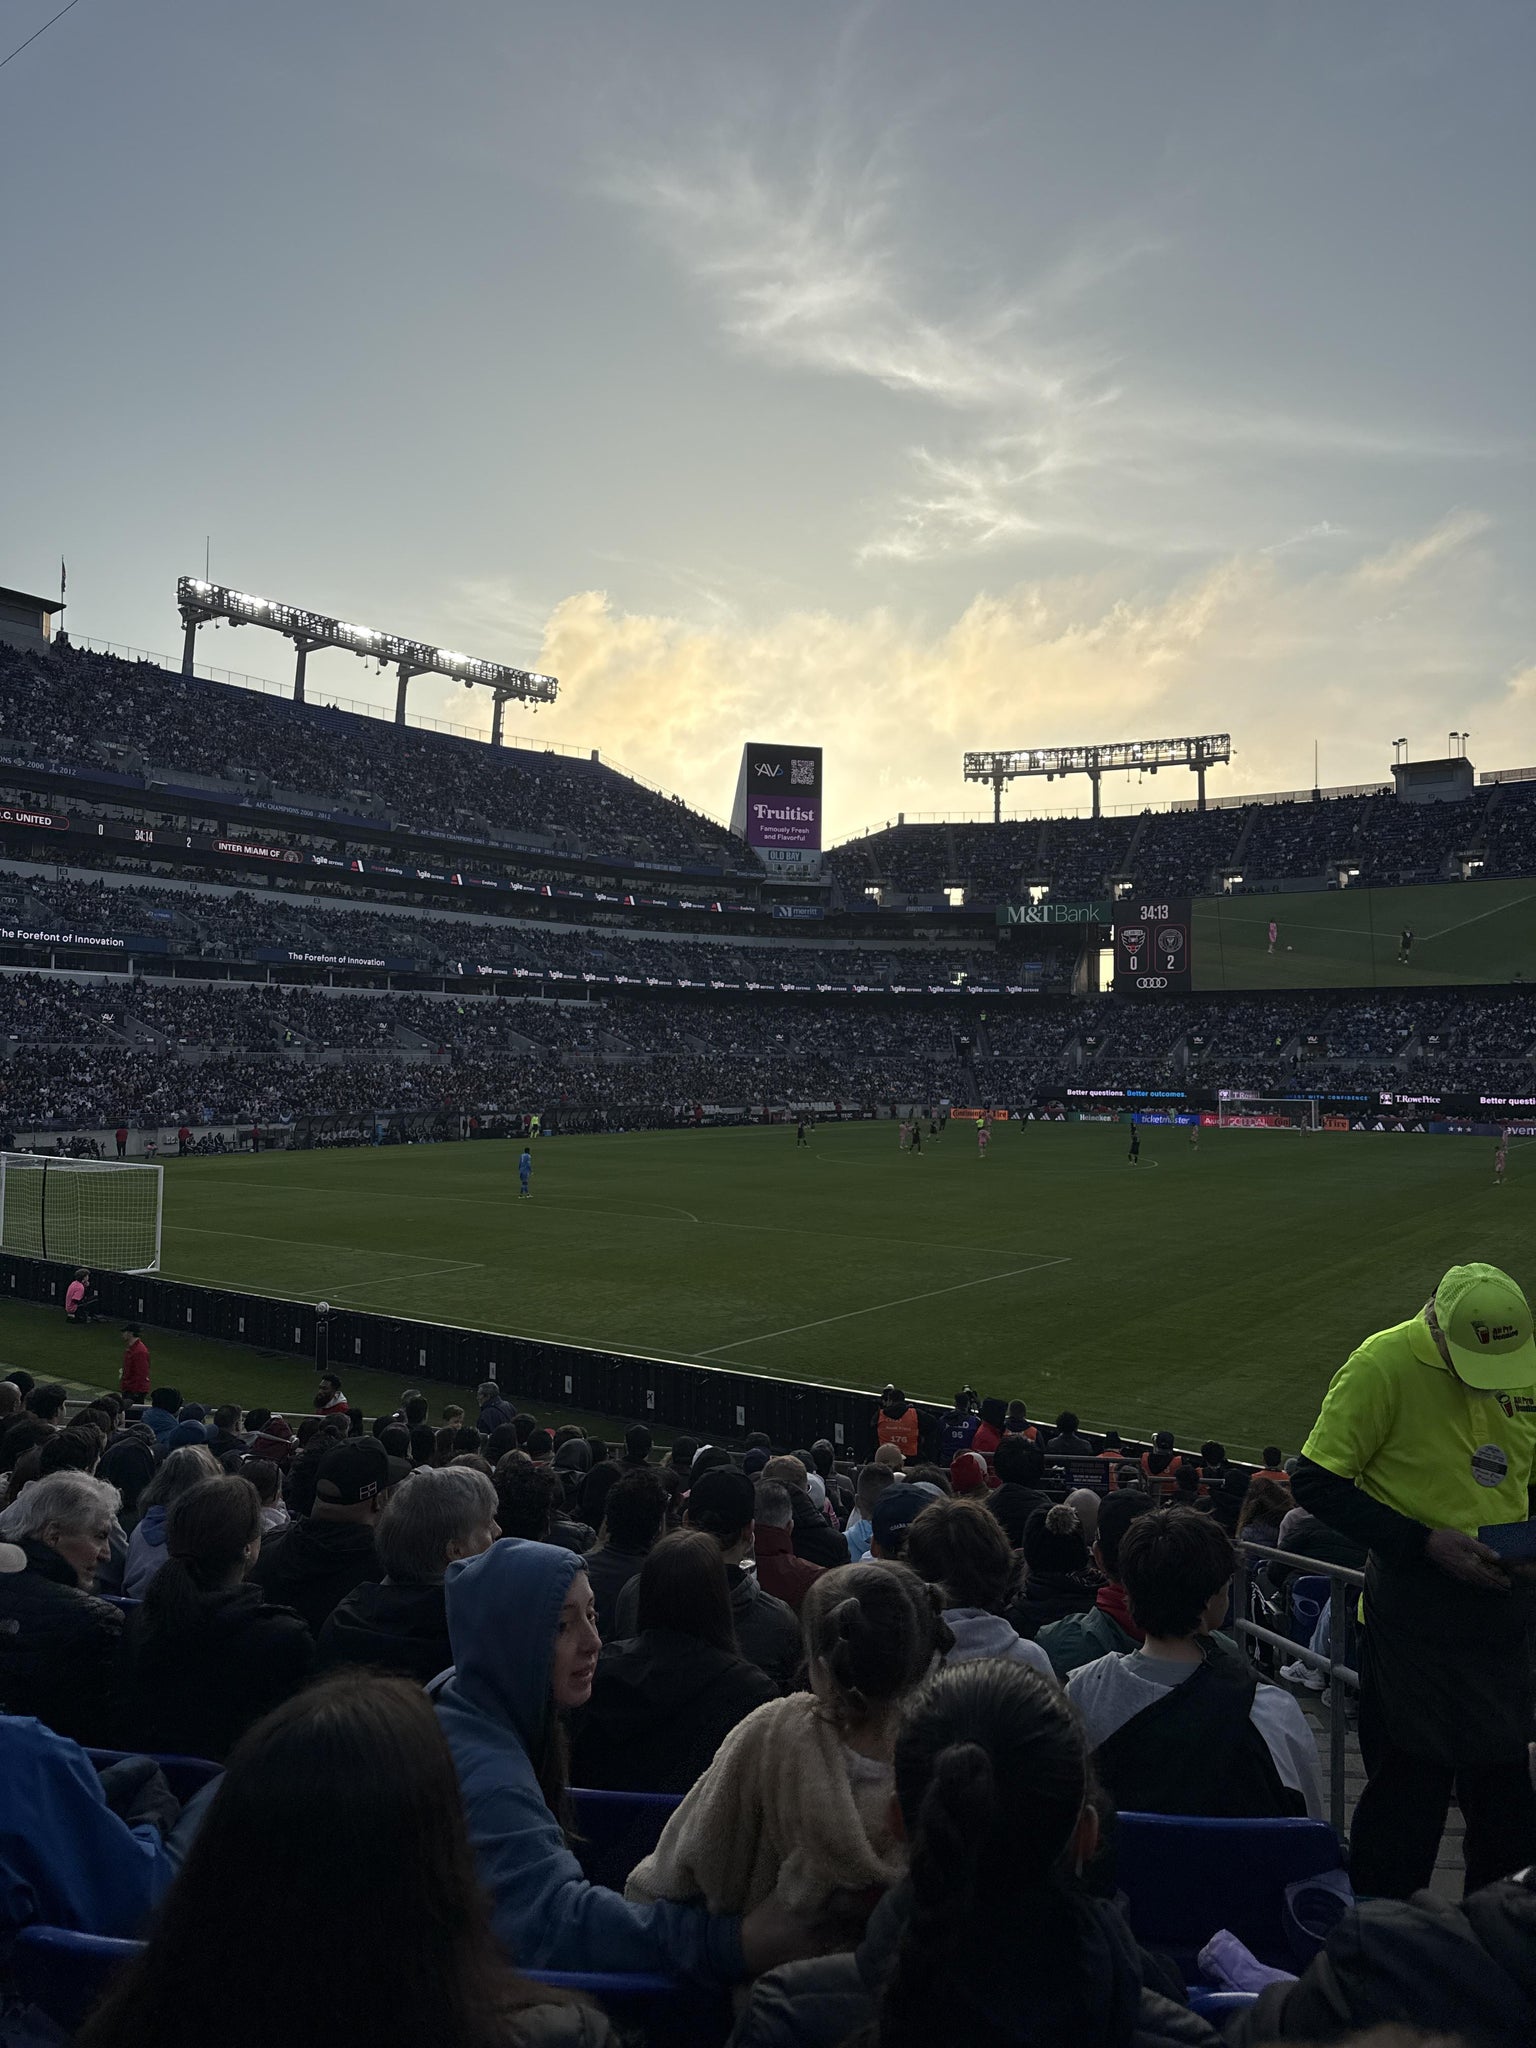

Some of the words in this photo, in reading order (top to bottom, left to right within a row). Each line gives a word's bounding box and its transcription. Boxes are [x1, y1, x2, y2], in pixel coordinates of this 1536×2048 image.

[27, 761, 45, 770] 2000
[59, 767, 77, 776] 2012
[267, 803, 299, 814] CHAMPIONS
[753, 804, 815, 821] Fruitist
[15, 812, 52, 826] UNITED
[98, 824, 104, 836] 0
[135, 829, 153, 842] 34:14
[760, 825, 790, 834] Famously
[186, 837, 192, 848] 2
[777, 833, 805, 841] Flavorful
[218, 842, 243, 853] INTER
[243, 844, 269, 856] MIAMI
[270, 850, 281, 858] CF
[770, 851, 785, 860] OLD
[785, 852, 800, 861] BAY
[1007, 905, 1054, 923] M&T
[1055, 904, 1100, 923] Bank
[1140, 905, 1169, 920] 34:13
[0, 928, 15, 938] he
[17, 929, 60, 942] Forefont
[62, 934, 73, 943] of
[74, 935, 124, 947] Innovation
[288, 952, 303, 960] The
[304, 953, 337, 963] Forefont
[338, 955, 347, 963] of
[347, 956, 385, 967] Innovation
[1130, 955, 1138, 970] 0
[1167, 955, 1175, 970] 2
[1089, 1089, 1126, 1098] questions.
[1126, 1089, 1148, 1097] Better
[1149, 1090, 1188, 1098] outcomes.
[1480, 1096, 1507, 1105] Better
[1508, 1097, 1536, 1107] questi
[1079, 1113, 1112, 1122] Heineken
